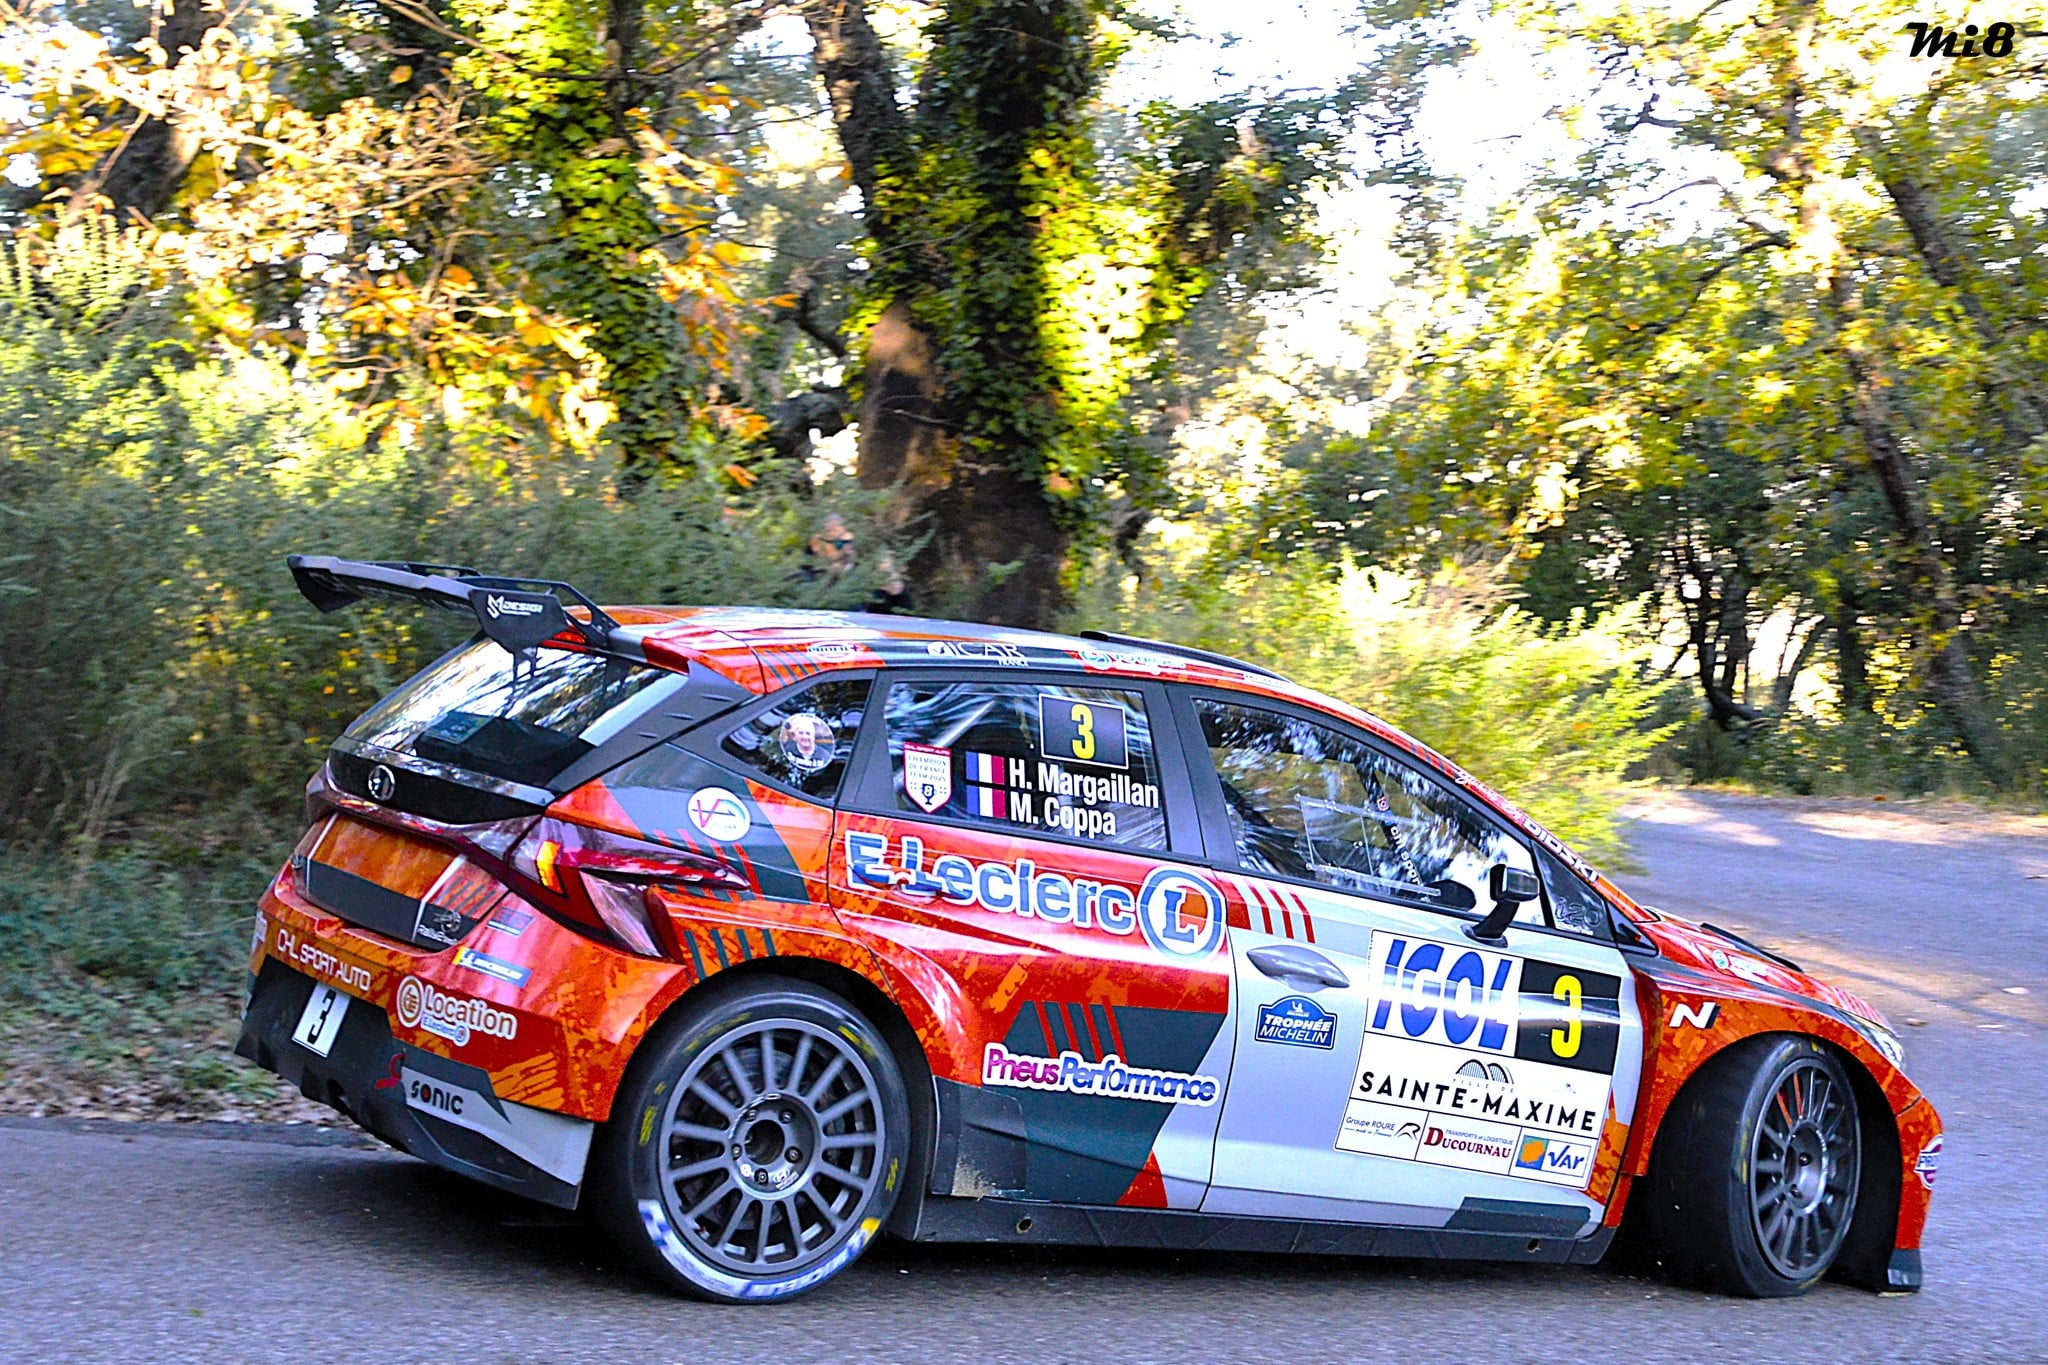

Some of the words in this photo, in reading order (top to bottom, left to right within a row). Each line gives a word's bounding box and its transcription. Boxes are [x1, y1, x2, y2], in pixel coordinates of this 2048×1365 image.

[1071, 704, 1095, 760] 3
[1009, 757, 1032, 790] H.
[1038, 762, 1159, 809] Margaillan
[1010, 791, 1038, 824] M.
[1044, 797, 1116, 839] Coppa
[300, 943, 337, 976] SPORT
[335, 961, 371, 992] AUTO
[307, 988, 337, 1045] 3
[424, 984, 517, 1040] Location
[1372, 939, 1513, 1050] IGOL
[1551, 974, 1583, 1058] 3
[1260, 1024, 1328, 1043] MICHELIN
[1265, 1013, 1332, 1032] TROPHÉE
[1346, 1117, 1371, 1129] Groupe
[1372, 1120, 1395, 1131] ROURE
[1359, 1071, 1596, 1132] SAINTE-MAXIME
[1445, 1129, 1478, 1140] TRANSPORTS
[1484, 1136, 1514, 1146] LOGISTIQUE
